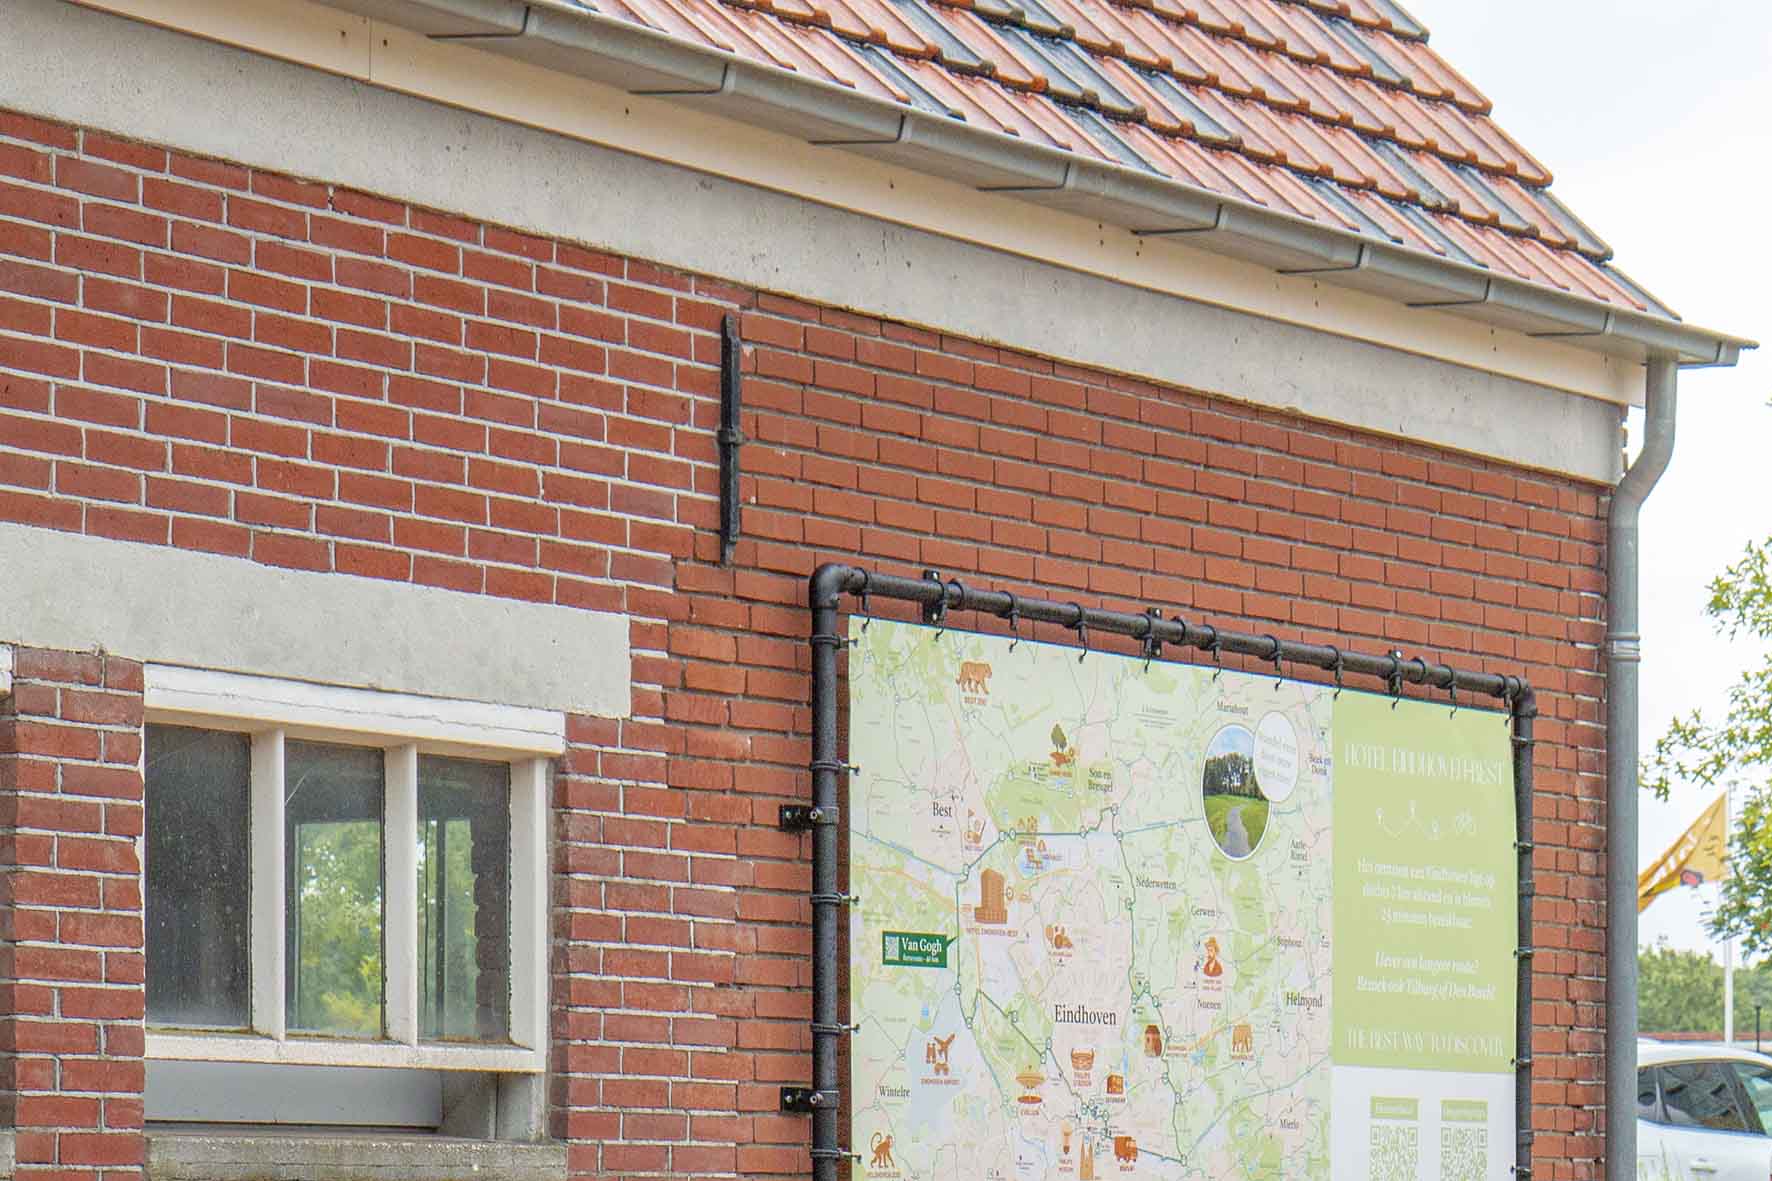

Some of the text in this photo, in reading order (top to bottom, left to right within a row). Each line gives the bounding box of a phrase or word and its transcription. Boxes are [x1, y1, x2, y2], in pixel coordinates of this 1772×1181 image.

[1088, 768, 1099, 779] Son
[932, 802, 952, 817] Best
[1136, 877, 1177, 889] Nederwetten
[1191, 906, 1216, 917] Gerwen
[902, 937, 942, 956] Van Gogh
[1286, 992, 1323, 1007] Helmond
[1054, 1004, 1116, 1025] Eindhoven
[880, 1085, 911, 1097] Wintelre
